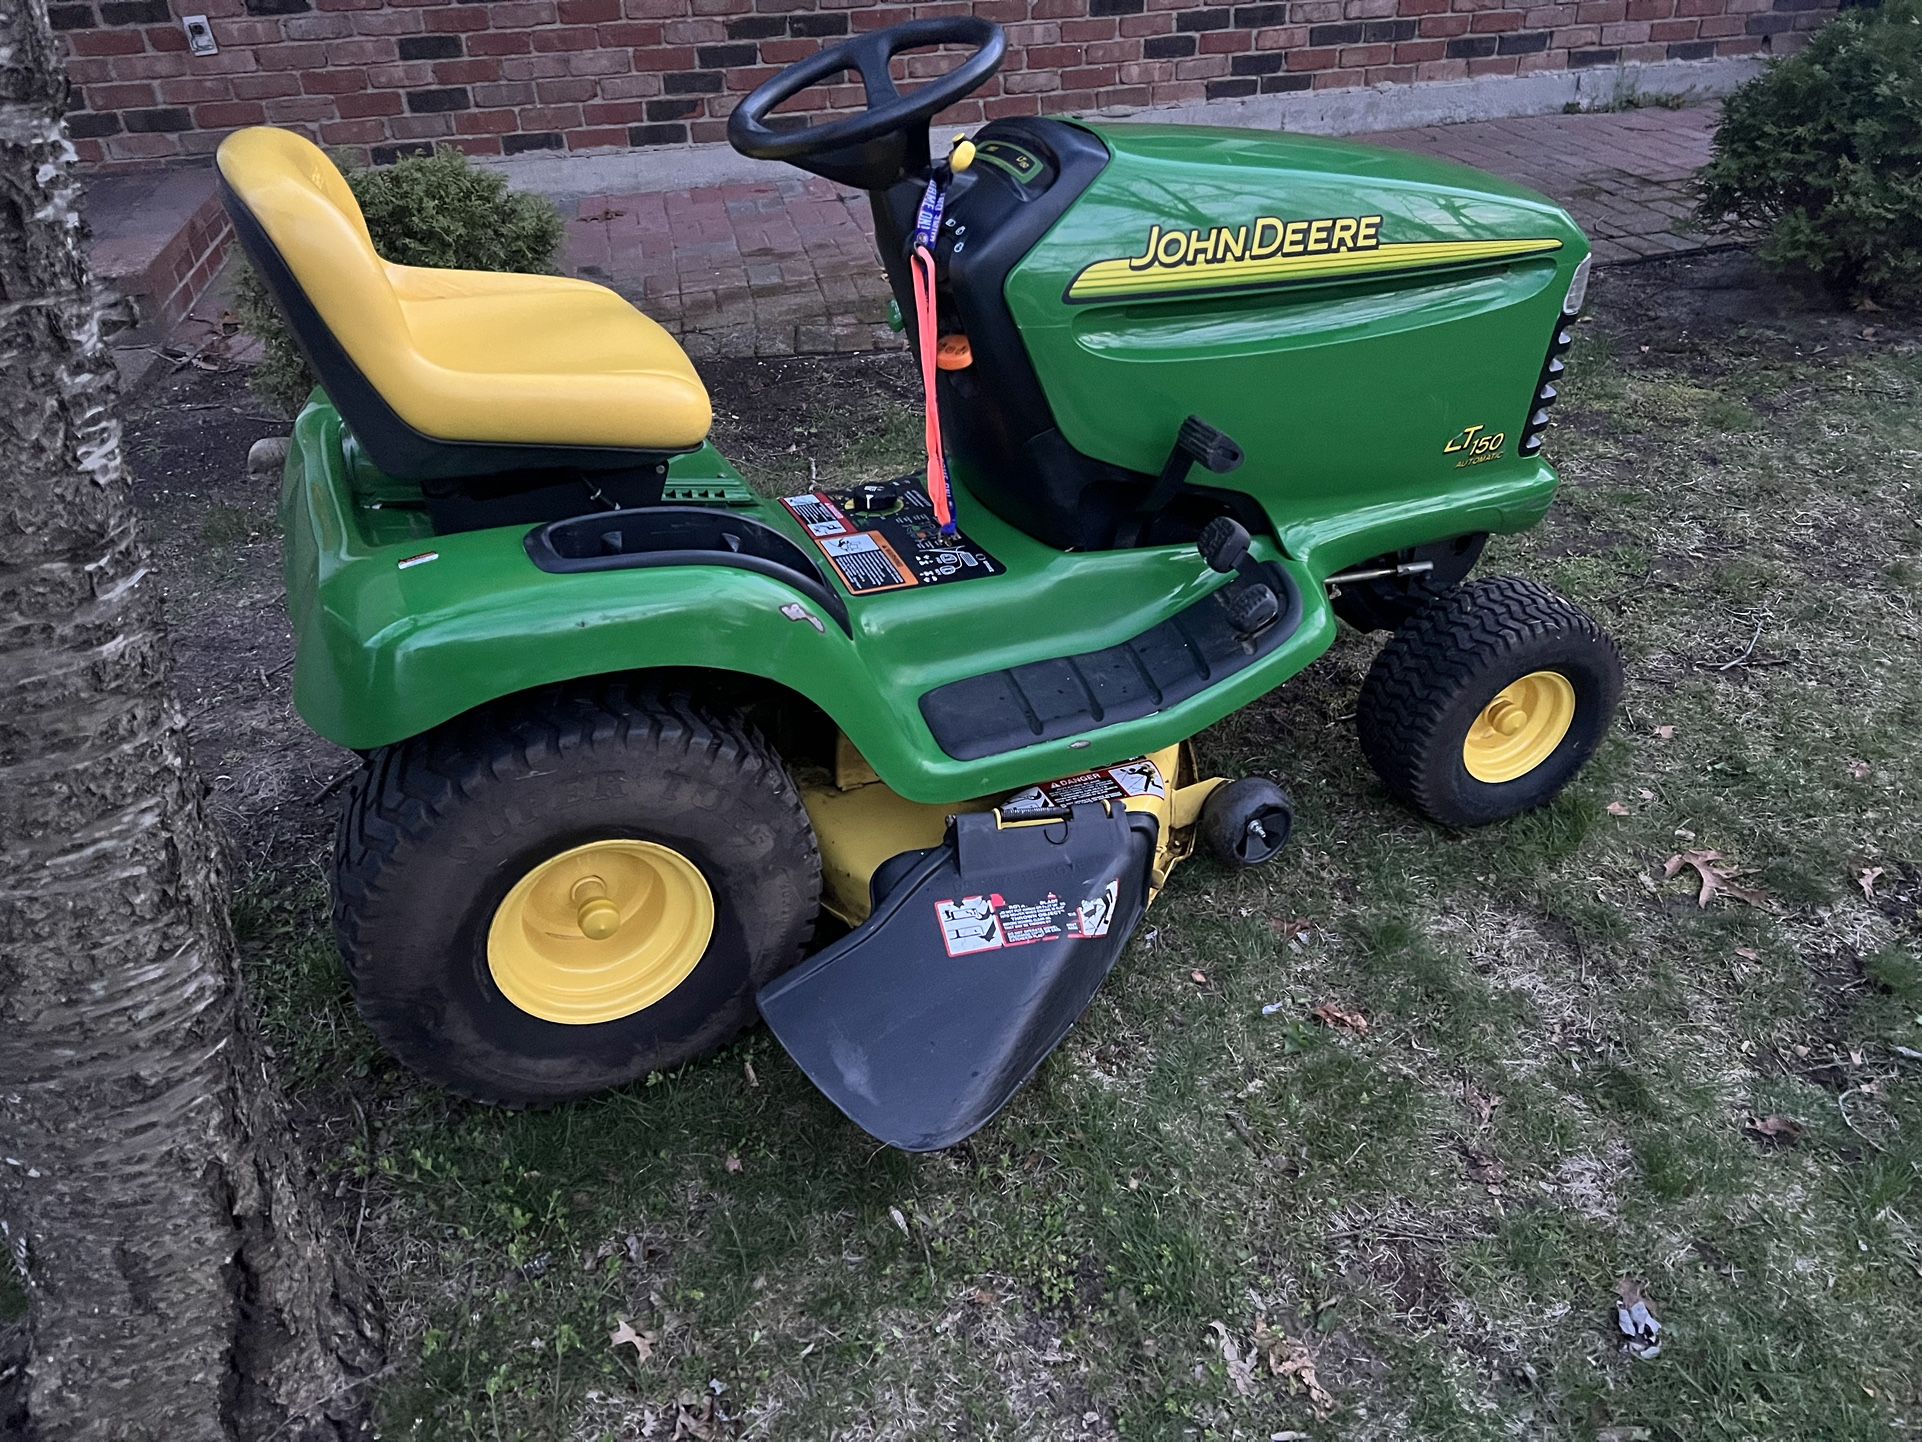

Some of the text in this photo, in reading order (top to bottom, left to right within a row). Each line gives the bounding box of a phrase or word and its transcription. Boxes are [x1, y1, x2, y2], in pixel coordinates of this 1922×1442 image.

[1130, 215, 1383, 270] JOHN DEERE
[1455, 451, 1504, 468] AUTOMATIC
[1059, 772, 1101, 786] DANGER
